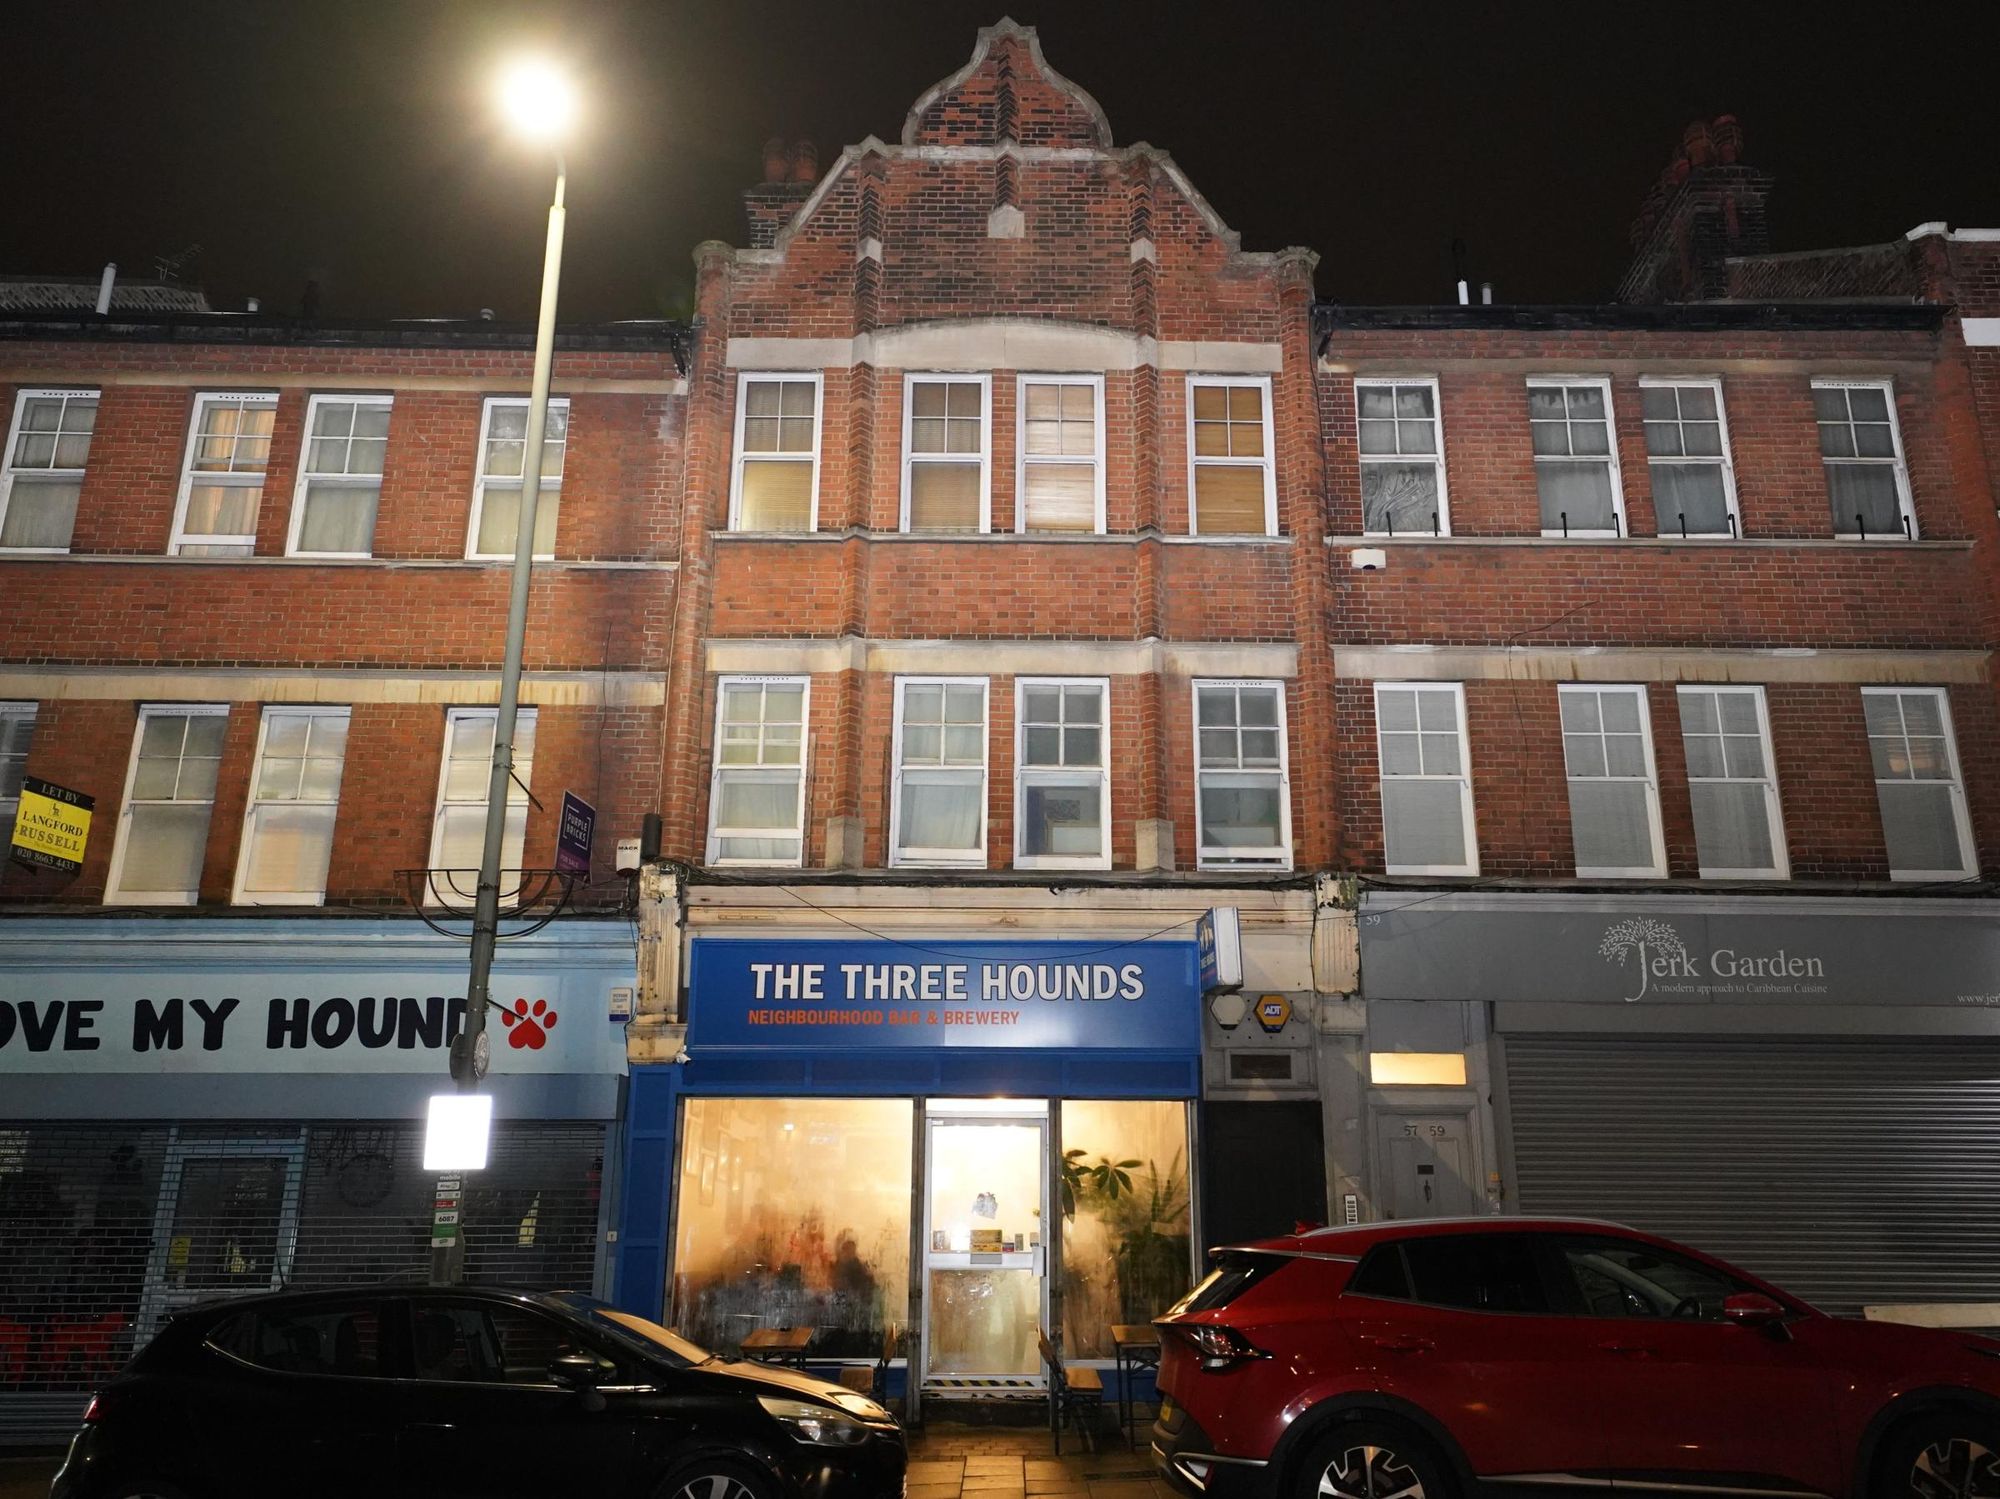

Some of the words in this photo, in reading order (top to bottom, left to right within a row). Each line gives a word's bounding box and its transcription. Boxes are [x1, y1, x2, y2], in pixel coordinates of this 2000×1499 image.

[41, 783, 62, 798] LET
[65, 790, 79, 804] BY
[23, 811, 83, 837] LANGFORD
[566, 823, 586, 842] BRICKS
[567, 813, 588, 832] PURPLE
[18, 825, 80, 852] RUSSELL
[1710, 949, 1825, 978] Garden
[750, 963, 825, 1000] THE
[840, 963, 968, 1001] THREE
[982, 963, 1145, 1001] HOUNDS
[1651, 983, 1660, 993] A
[1661, 982, 1695, 993] modern
[1697, 982, 1733, 996] approach
[1735, 983, 1745, 993] to
[1746, 982, 1792, 994] Caribbean
[1793, 982, 1828, 994] Cuisine
[748, 1010, 883, 1025] NEIGHBOURHOOD
[888, 1010, 921, 1025] BAR
[926, 1010, 938, 1025] &
[943, 1010, 1020, 1025] BREWERY
[1264, 1005, 1281, 1016] ADT
[133, 998, 240, 1052] MY
[1404, 1125, 1418, 1136] 57
[1430, 1125, 1446, 1137] 59
